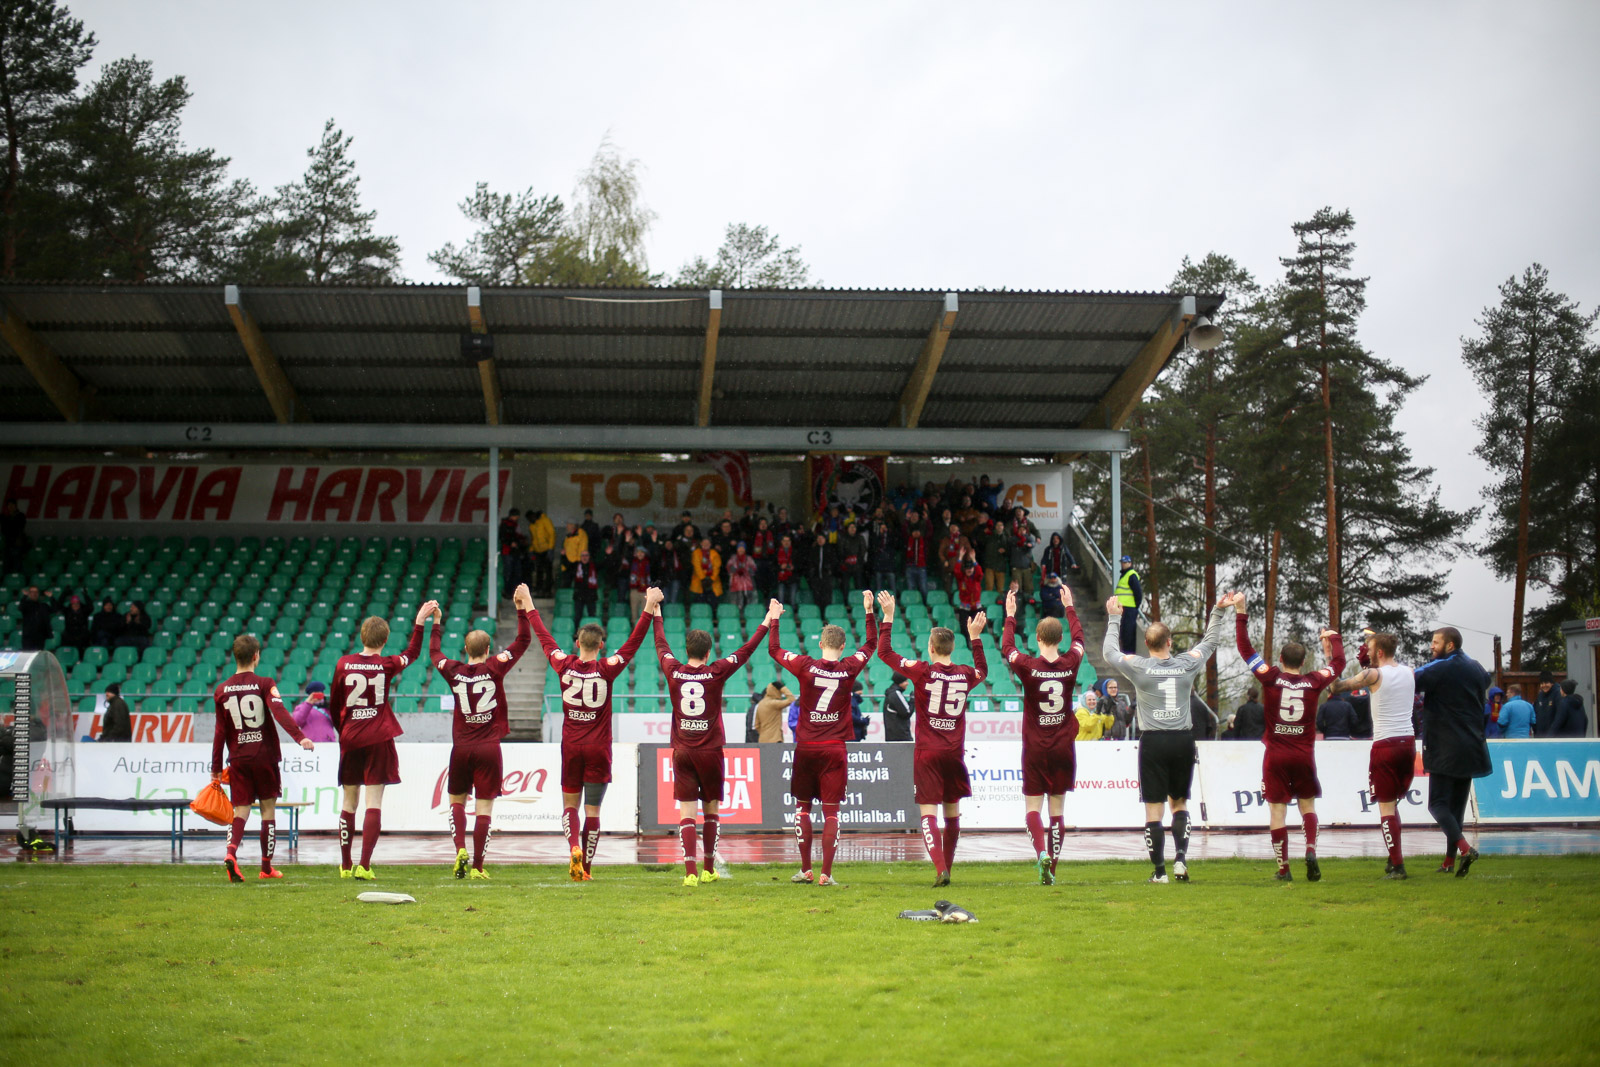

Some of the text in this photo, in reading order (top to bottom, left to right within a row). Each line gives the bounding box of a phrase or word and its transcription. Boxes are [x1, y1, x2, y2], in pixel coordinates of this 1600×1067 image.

[3, 465, 244, 521] HARVIA
[267, 467, 510, 523] HARVIA
[349, 663, 384, 671] KESKIMAA
[678, 672, 713, 680] KESKIMAA
[815, 669, 849, 678] KESKIMAA
[1037, 669, 1073, 678] KESKIMAA
[1151, 667, 1186, 676] KESKIMAA
[228, 684, 259, 693] KESKIMAA
[345, 673, 386, 707] 21
[452, 680, 497, 715] 12
[561, 674, 608, 708] 20
[814, 677, 840, 712] 7
[925, 679, 968, 716] 15
[1039, 680, 1064, 714] 3
[1157, 677, 1177, 711] 1
[680, 682, 706, 717] 8
[1279, 688, 1305, 722] 5
[223, 694, 265, 730] 19
[352, 708, 378, 720] GRANO
[465, 713, 492, 723] GRANO
[569, 711, 596, 720] GRANO
[810, 712, 839, 721] GRANO
[1152, 709, 1181, 719] GRANO
[89, 714, 194, 742] HRVI
[680, 721, 708, 729] GRANO
[929, 718, 956, 728] GRANO
[1275, 725, 1304, 734] GRANO
[237, 732, 263, 743] GRANO
[968, 769, 1024, 781] HYUND
[586, 828, 600, 864] TOTAL
[1051, 822, 1060, 860] TOTAL
[1276, 840, 1285, 870] TOTAL
